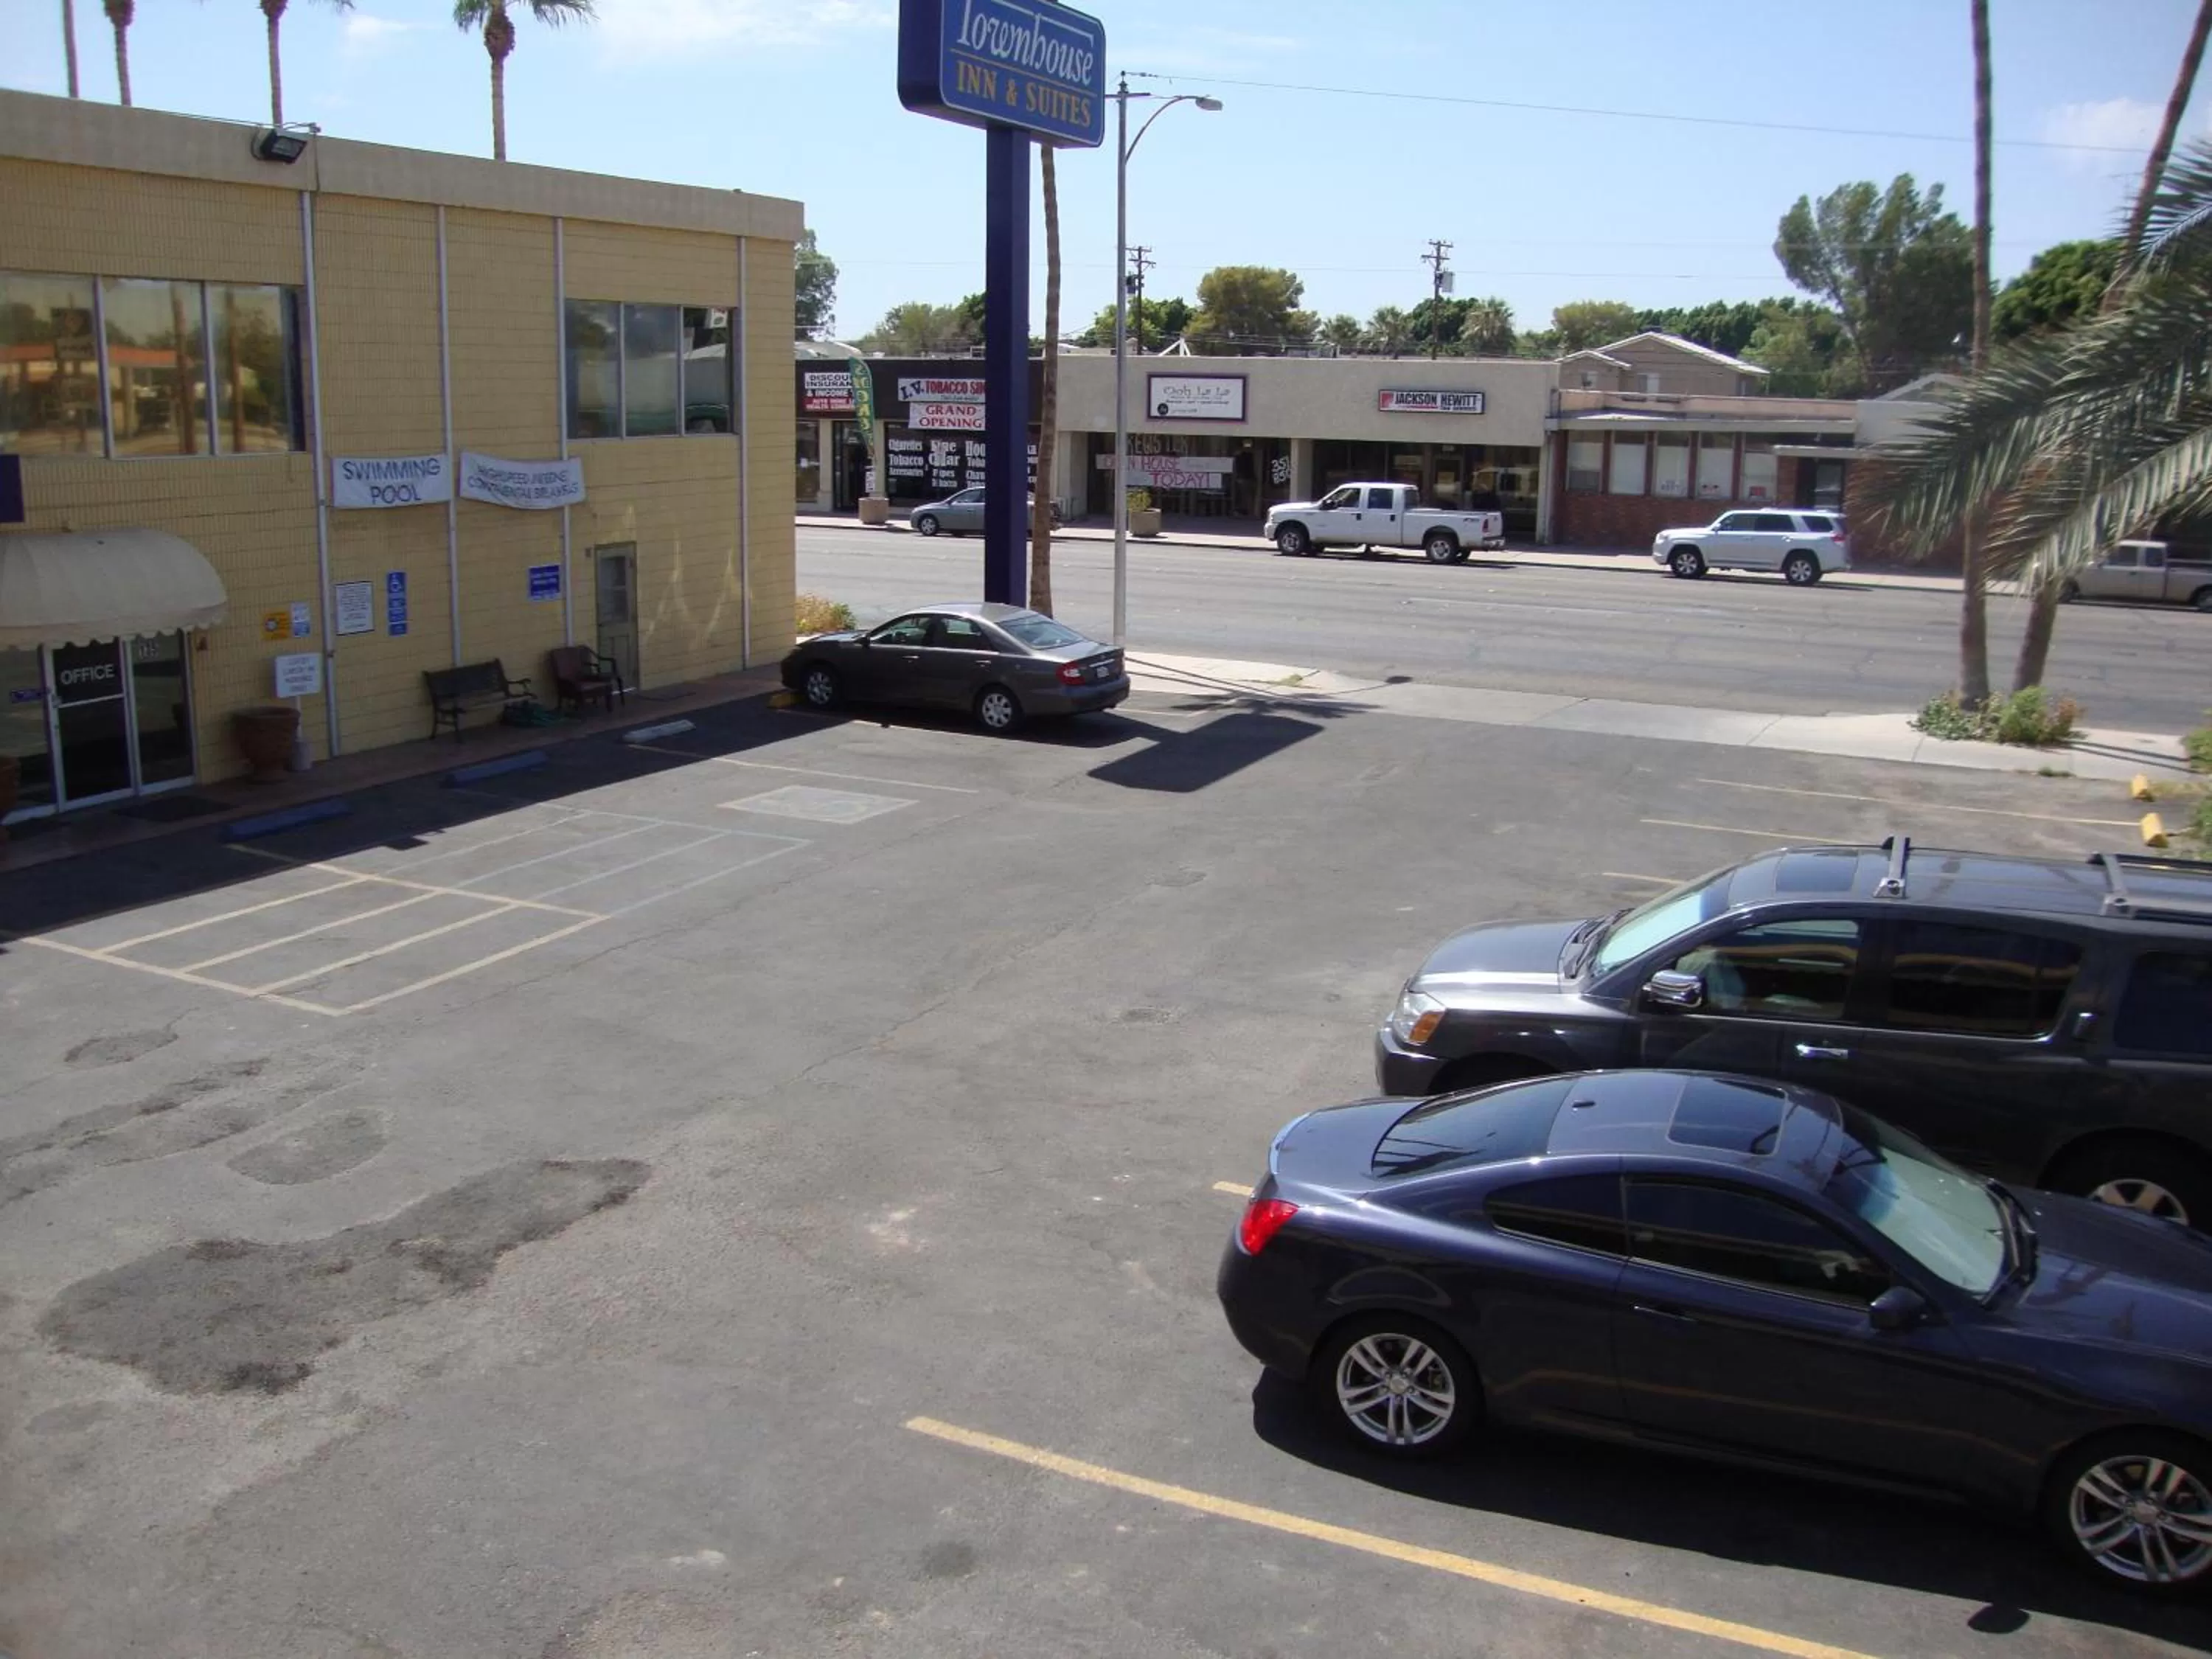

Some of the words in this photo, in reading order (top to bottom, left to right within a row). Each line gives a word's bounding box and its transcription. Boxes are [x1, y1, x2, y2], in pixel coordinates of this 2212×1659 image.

[957, 0, 1094, 86] Townhouse
[958, 60, 997, 102] INN
[1006, 79, 1018, 106] &
[1026, 82, 1091, 128] SUITES
[926, 380, 967, 394] TOBACCO
[1395, 393, 1437, 405] JACKSON
[1441, 394, 1478, 406] HEWITT
[925, 405, 977, 416] GRAND
[919, 417, 982, 428] OPENING
[965, 440, 985, 456] Hoo
[888, 454, 924, 466] Tobacco
[341, 456, 442, 481] SWIMMING
[370, 484, 422, 505] POOL
[60, 663, 116, 685] OFFICE
